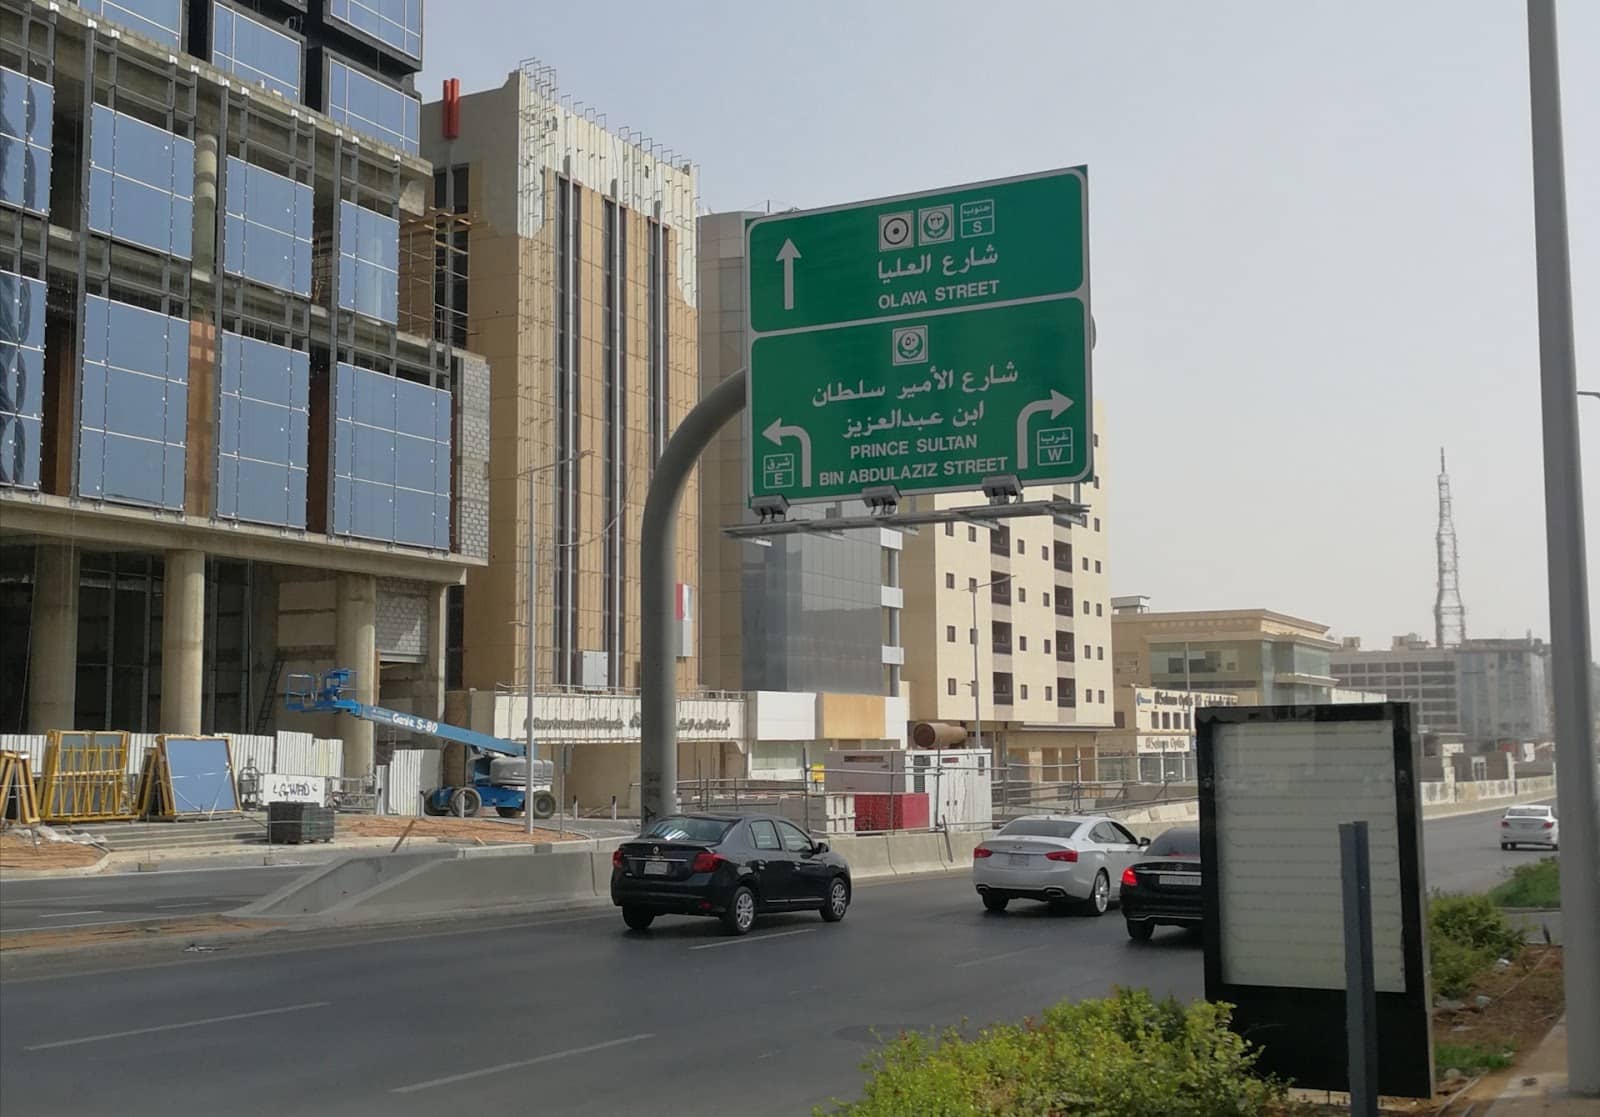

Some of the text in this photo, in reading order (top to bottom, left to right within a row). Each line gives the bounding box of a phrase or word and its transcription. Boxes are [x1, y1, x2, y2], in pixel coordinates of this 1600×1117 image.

[963, 205, 991, 215] جنوب
[973, 221, 983, 233] S
[877, 243, 999, 284] شارع العليا
[878, 280, 1000, 309] OLAYA STREET
[812, 361, 1019, 407] شارع الأمير سلطان
[843, 400, 984, 438] ابن عبدالعزيز
[850, 434, 978, 459] PRINCE SULTAN
[1040, 431, 1070, 445] غرب
[767, 456, 791, 470] شرق
[1047, 447, 1063, 461] W
[774, 472, 784, 485] E
[819, 456, 1008, 486] BIN ABDULAZIZ STREET
